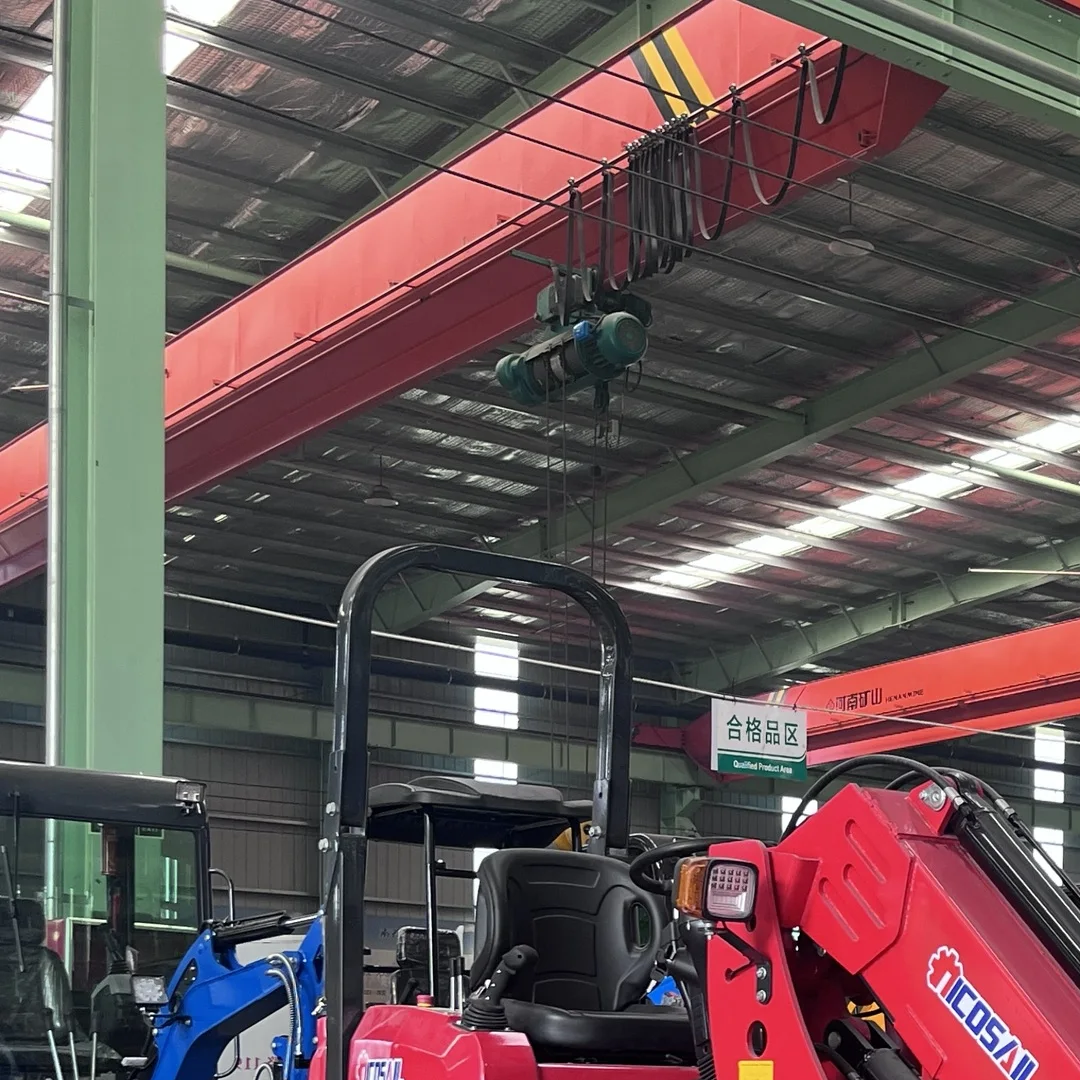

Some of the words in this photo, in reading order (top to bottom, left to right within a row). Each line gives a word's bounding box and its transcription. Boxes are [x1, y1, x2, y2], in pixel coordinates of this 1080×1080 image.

[835, 687, 883, 711] 河南矿山
[726, 714, 799, 747] 合格品区
[733, 759, 757, 770] Qualified
[758, 762, 780, 773] Product
[780, 764, 793, 774] Area
